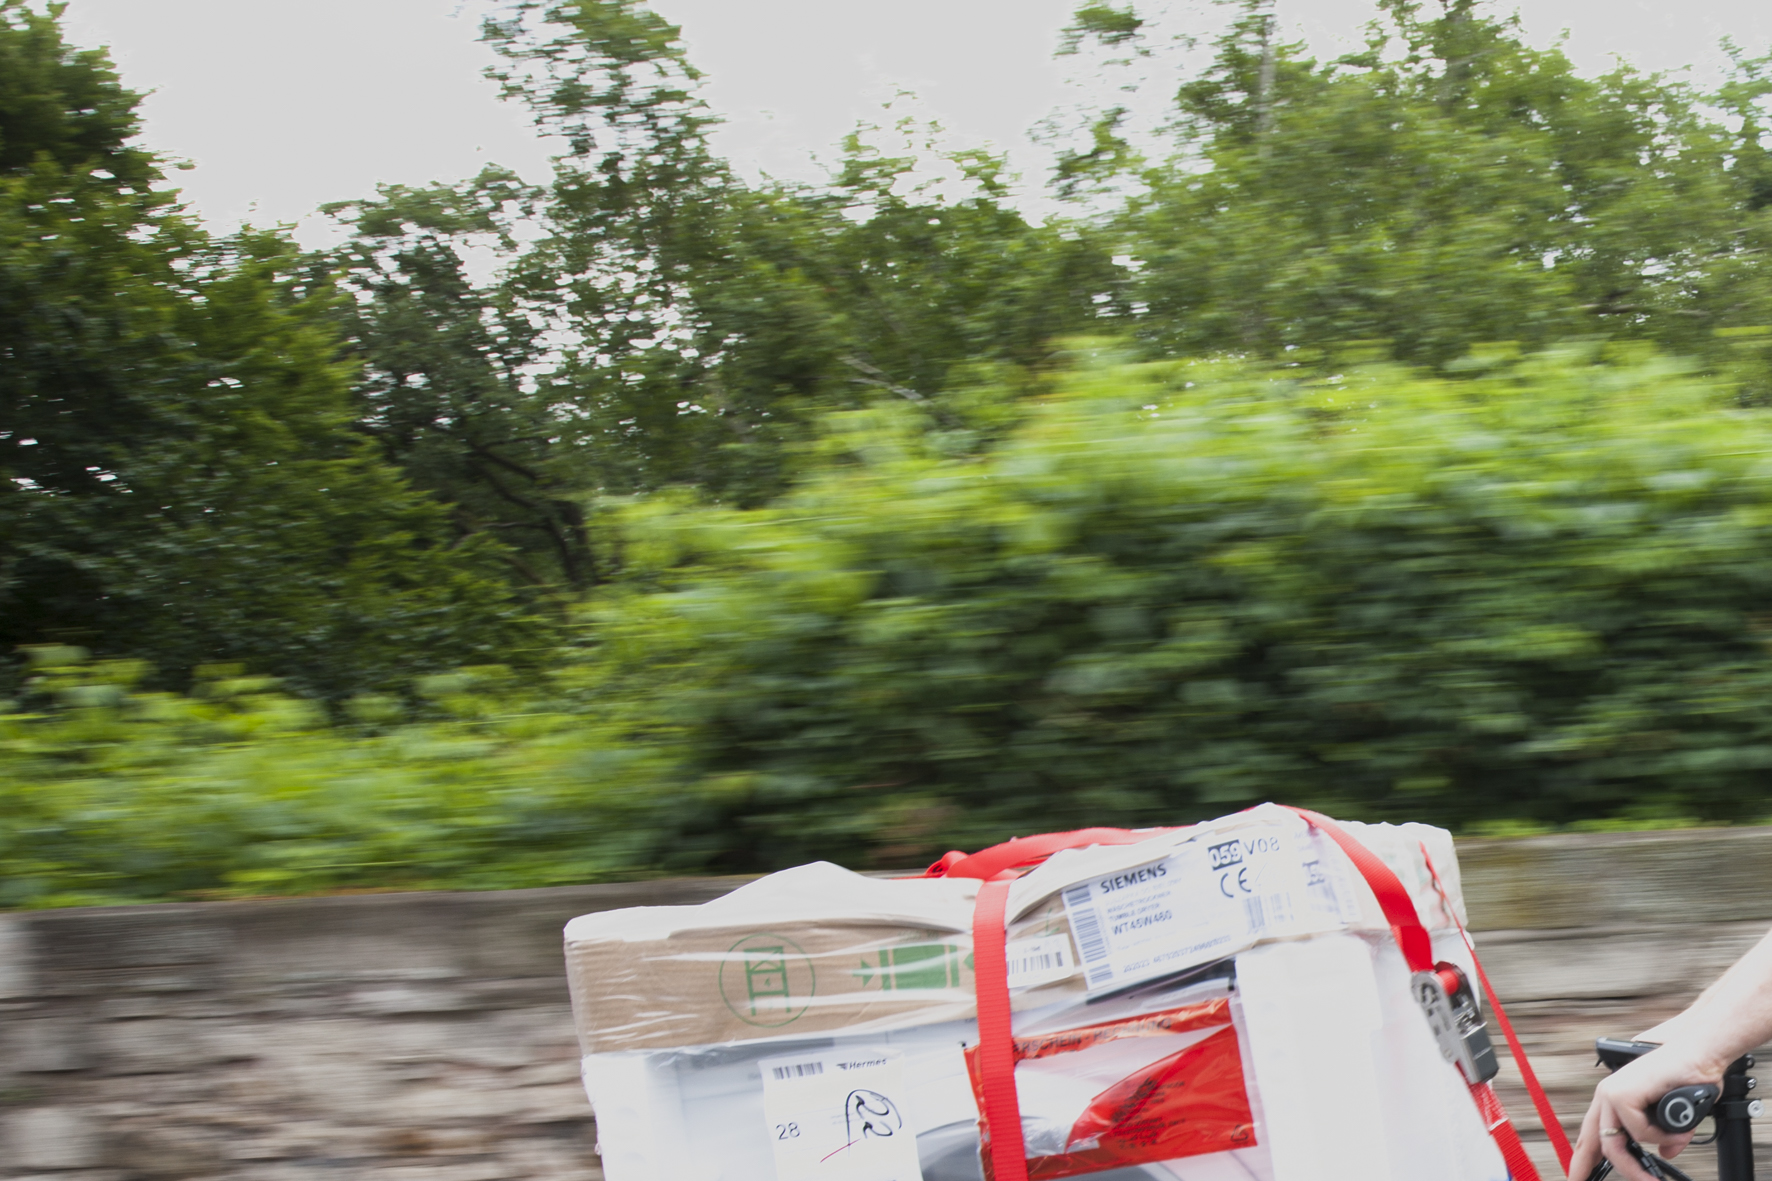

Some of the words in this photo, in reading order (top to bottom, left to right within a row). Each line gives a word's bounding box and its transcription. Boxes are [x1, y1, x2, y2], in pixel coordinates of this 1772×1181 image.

[1210, 841, 1241, 868] 059
[1243, 836, 1280, 855] V08
[1100, 862, 1168, 894] SIEMENS
[776, 1121, 801, 1140] 28
